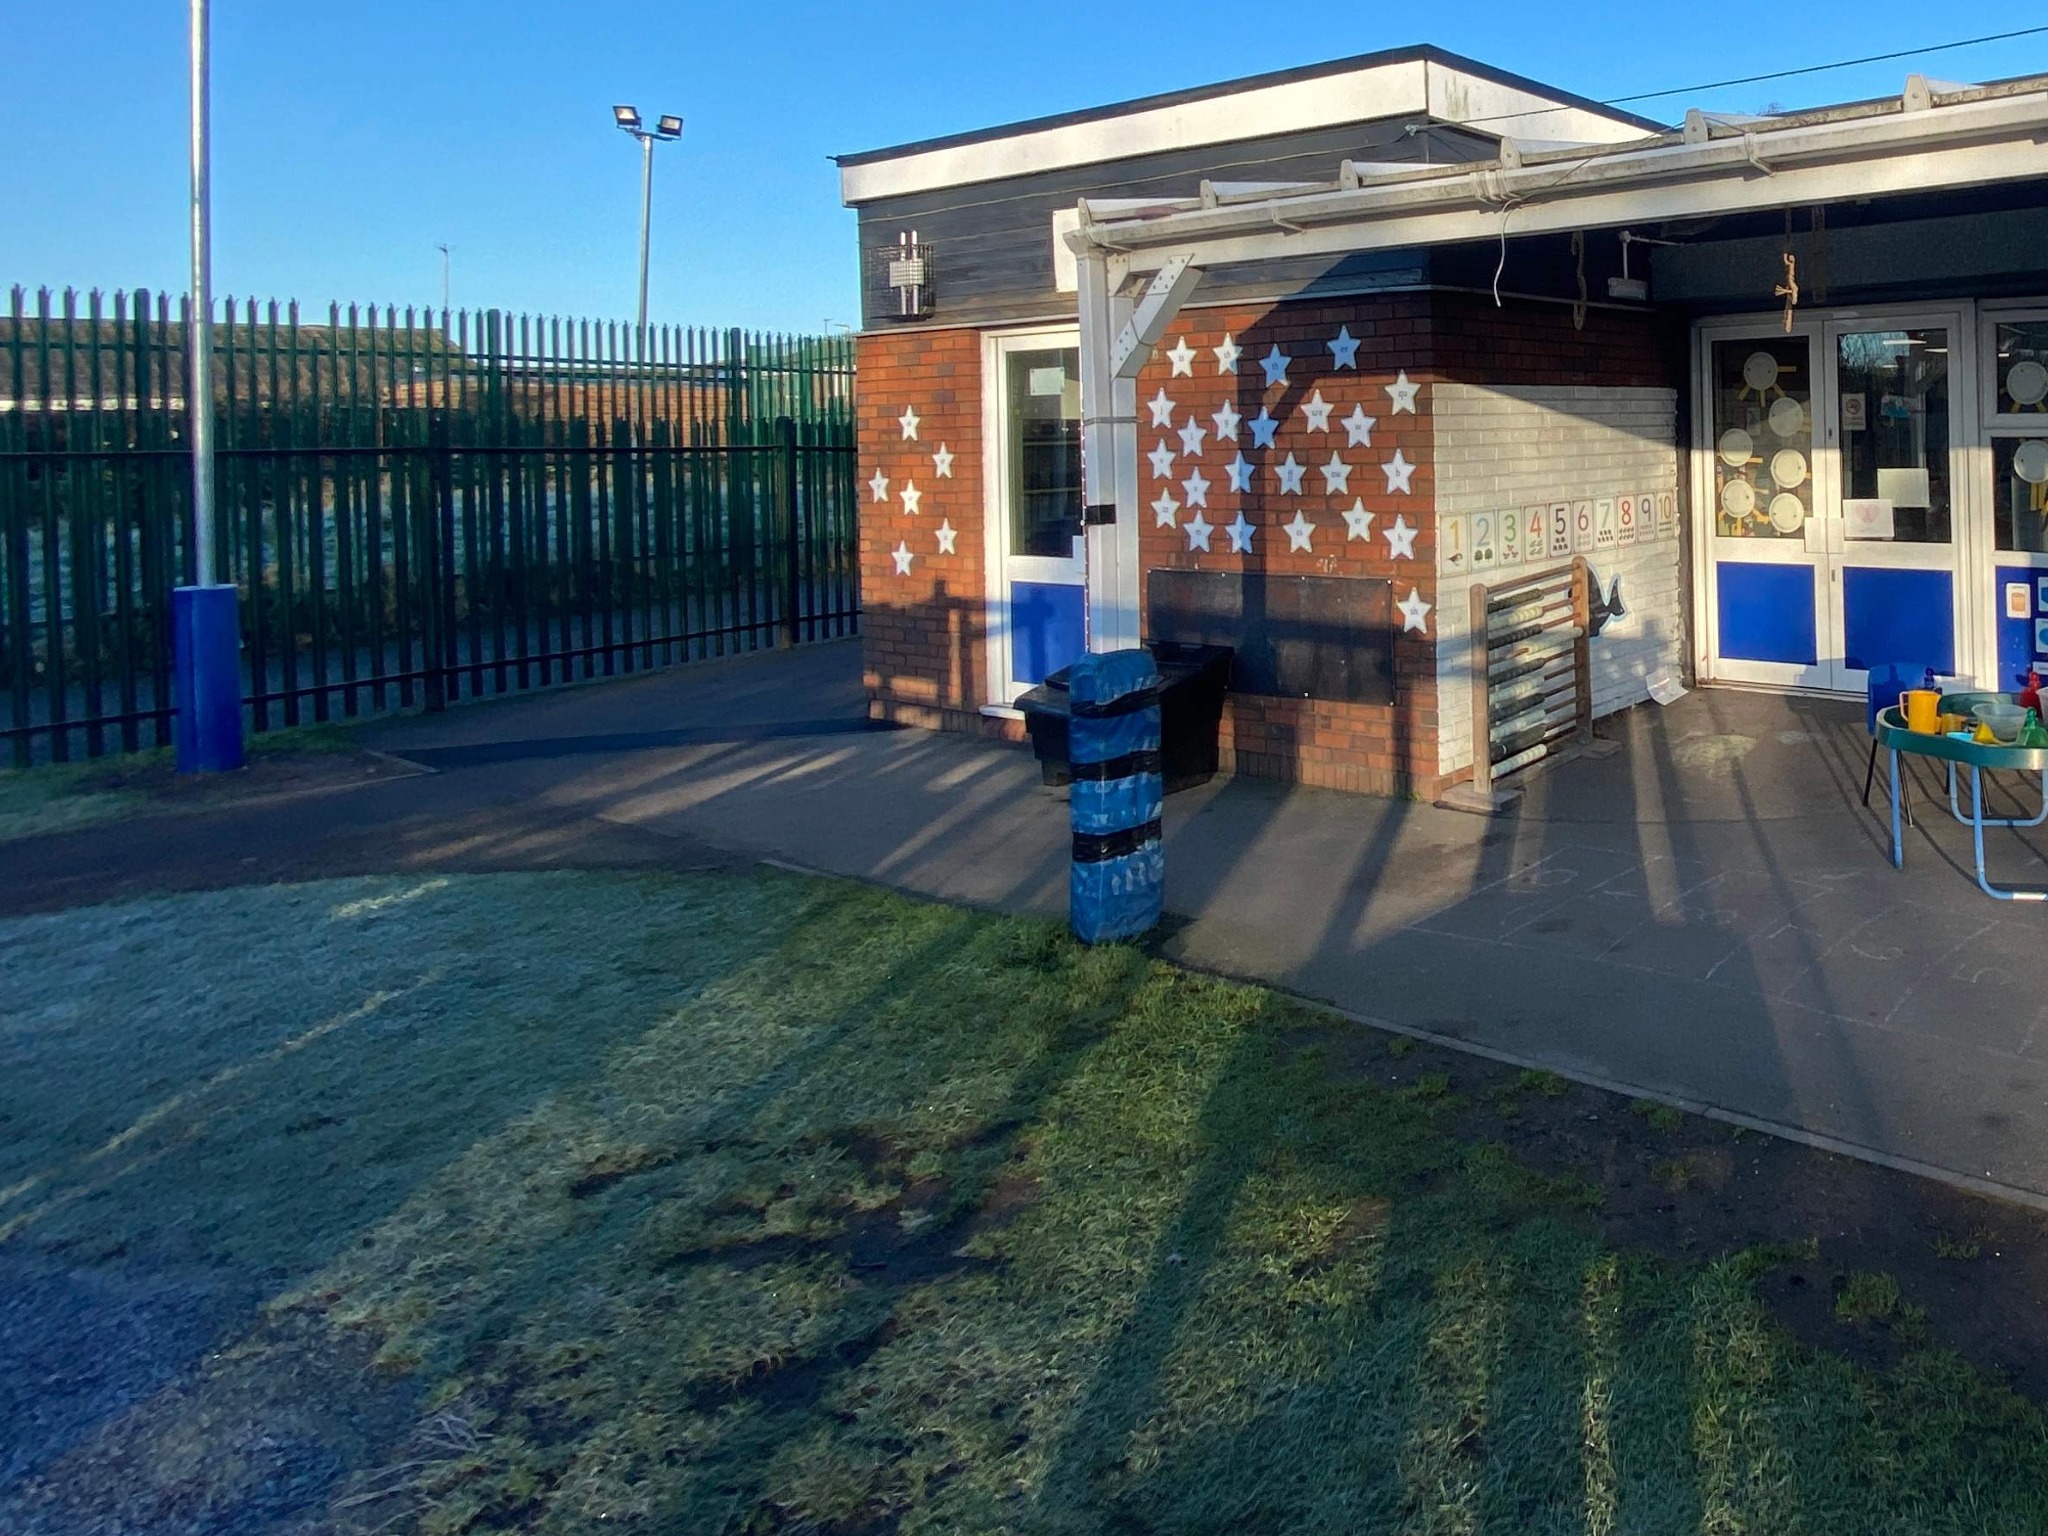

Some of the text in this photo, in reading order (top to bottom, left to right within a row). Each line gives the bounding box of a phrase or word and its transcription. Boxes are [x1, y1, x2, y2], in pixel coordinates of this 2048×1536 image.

[1450, 496, 1670, 550] 1 2 3 4 5 6 7 8 9 10
